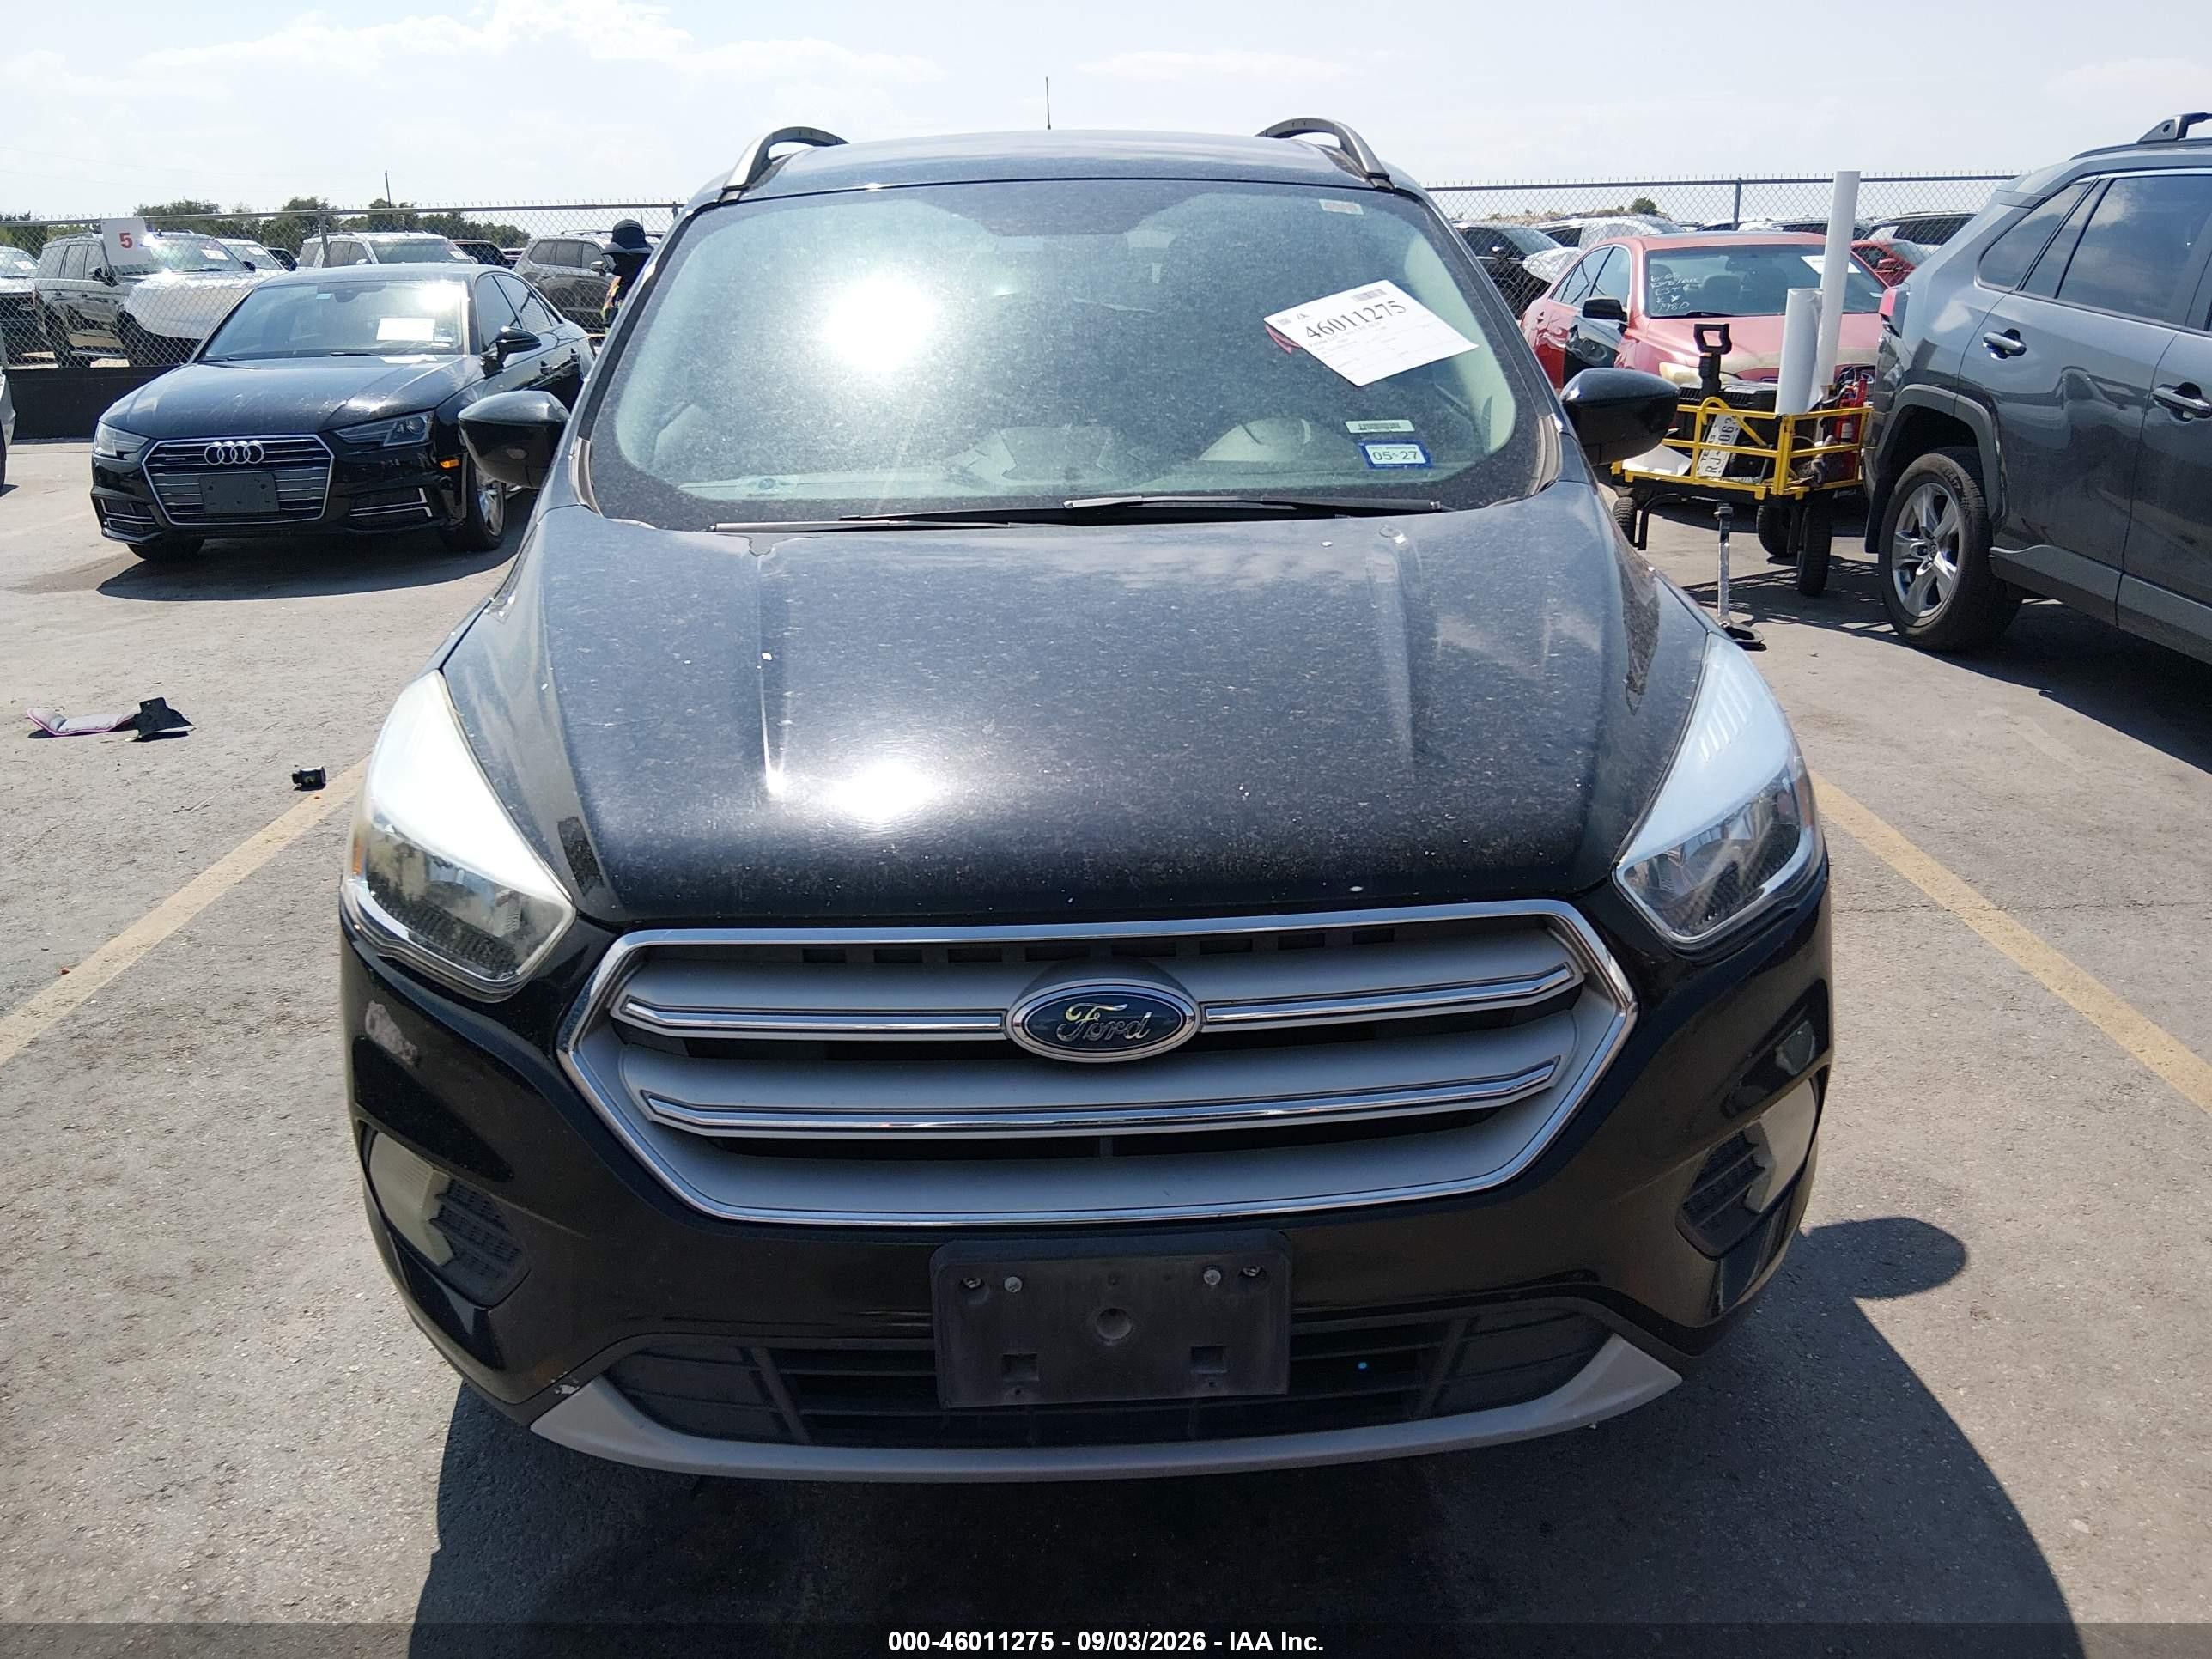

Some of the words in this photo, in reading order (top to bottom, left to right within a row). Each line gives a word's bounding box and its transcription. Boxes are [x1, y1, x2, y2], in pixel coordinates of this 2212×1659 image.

[119, 233, 133, 249] 5
[1305, 300, 1407, 340] 46011275
[1056, 1002, 1153, 1042] Ford
